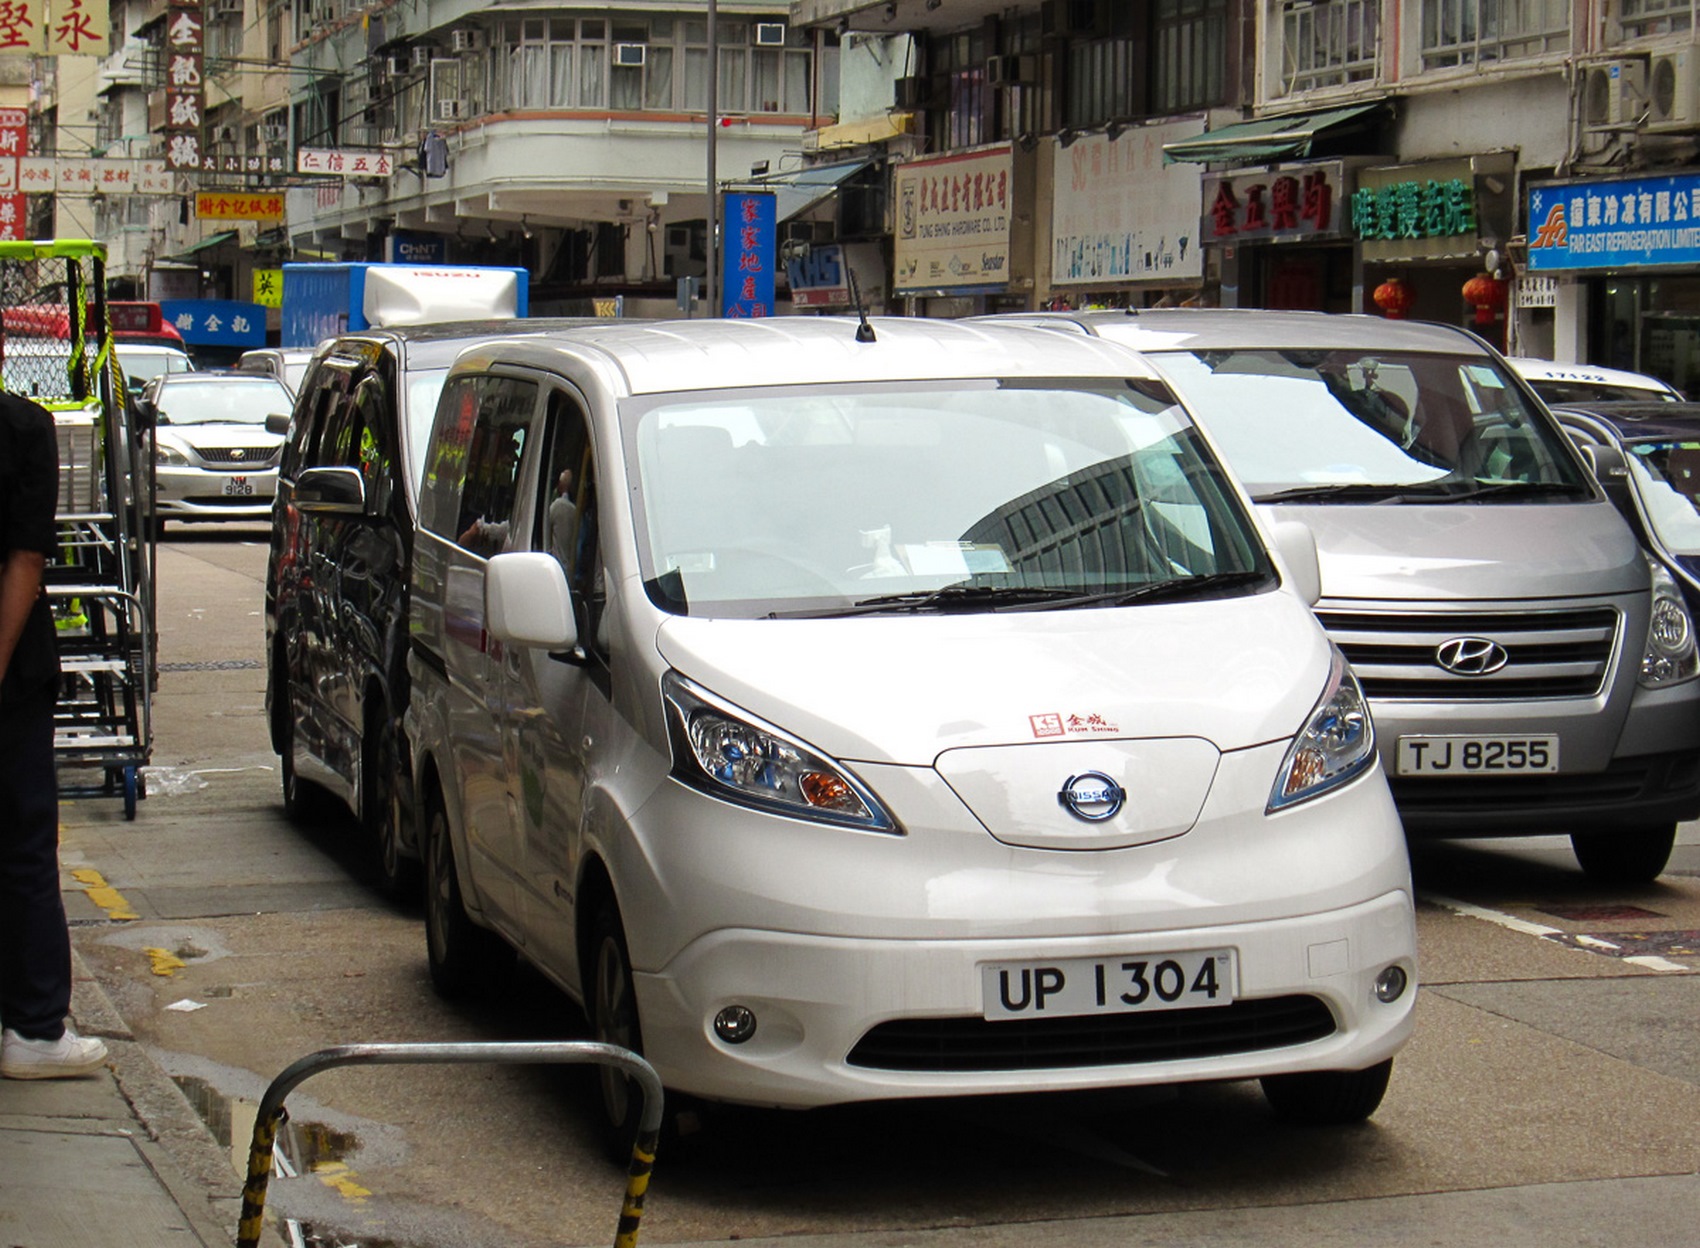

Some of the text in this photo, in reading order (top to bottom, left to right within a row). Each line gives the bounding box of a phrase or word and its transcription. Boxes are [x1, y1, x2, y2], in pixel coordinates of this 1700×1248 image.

[303, 153, 390, 175] 仁信五金
[919, 224, 933, 238] TUNG
[934, 222, 951, 237] SHING
[952, 219, 981, 236] HARDWARE
[739, 200, 762, 300] 家家地產
[1570, 233, 1585, 253] FAR
[1586, 232, 1605, 252] EAST
[1606, 229, 1671, 251] REFRIGERATION
[256, 273, 274, 295] 英
[1546, 371, 1607, 382] 17122
[225, 485, 253, 495] 9128
[1409, 741, 1549, 770] TJ 8255
[1066, 787, 1121, 801] NISSAN
[1000, 957, 1219, 1011] UP 1304
